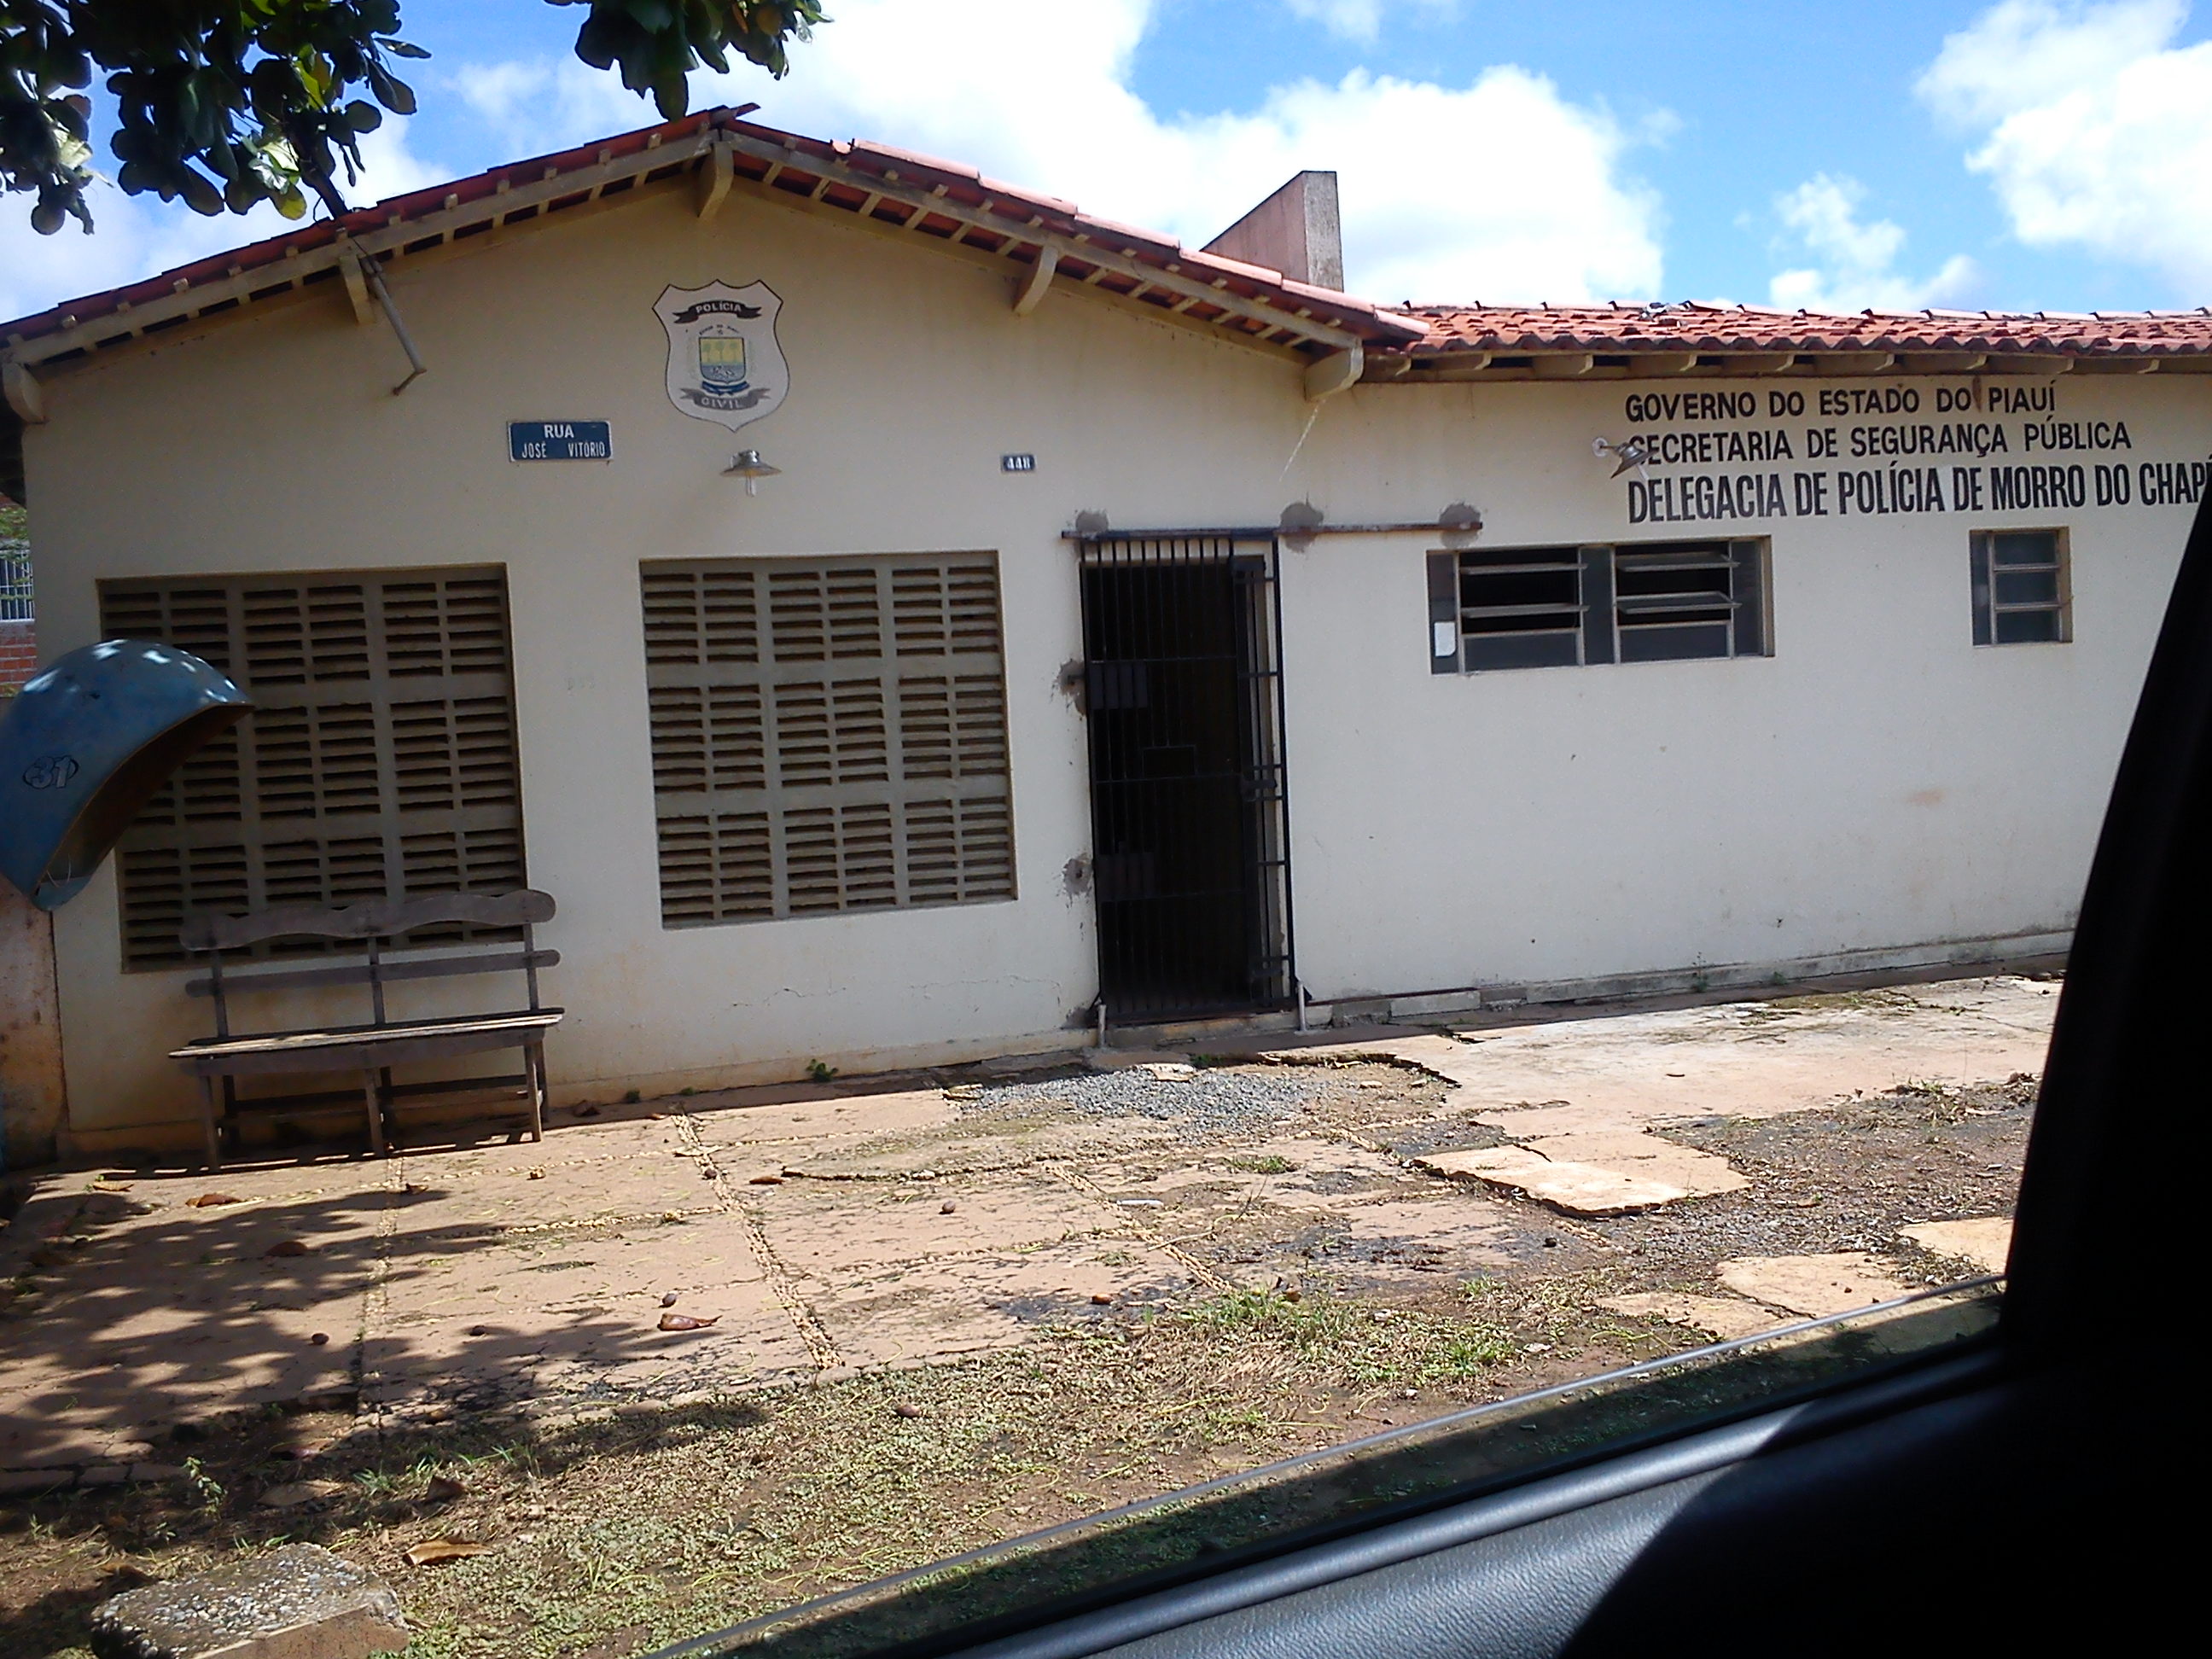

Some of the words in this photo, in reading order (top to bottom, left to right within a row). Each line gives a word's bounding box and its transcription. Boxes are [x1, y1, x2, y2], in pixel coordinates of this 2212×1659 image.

[696, 300, 742, 313] POLÍCIA
[701, 397, 744, 410] CIVIL
[1625, 391, 1756, 422] GOVERNO
[1769, 390, 1805, 417] DO
[1819, 387, 1919, 416] ESTADO
[1936, 387, 1971, 412] DO
[1988, 380, 2056, 413] PIAUÍ
[544, 423, 574, 439] RUA
[1807, 428, 1838, 458] DE
[1850, 422, 2008, 457] SEGURANÇA
[2023, 415, 2132, 451] PÚBLICA
[521, 441, 547, 458] JOSÉ
[1627, 474, 1788, 524] DELEGACIA
[1794, 471, 1828, 516] DE
[1837, 460, 1945, 515] POLÍCIA
[1953, 467, 1983, 511] DE
[1990, 464, 2086, 510] MORRO
[2094, 463, 2131, 506] DO
